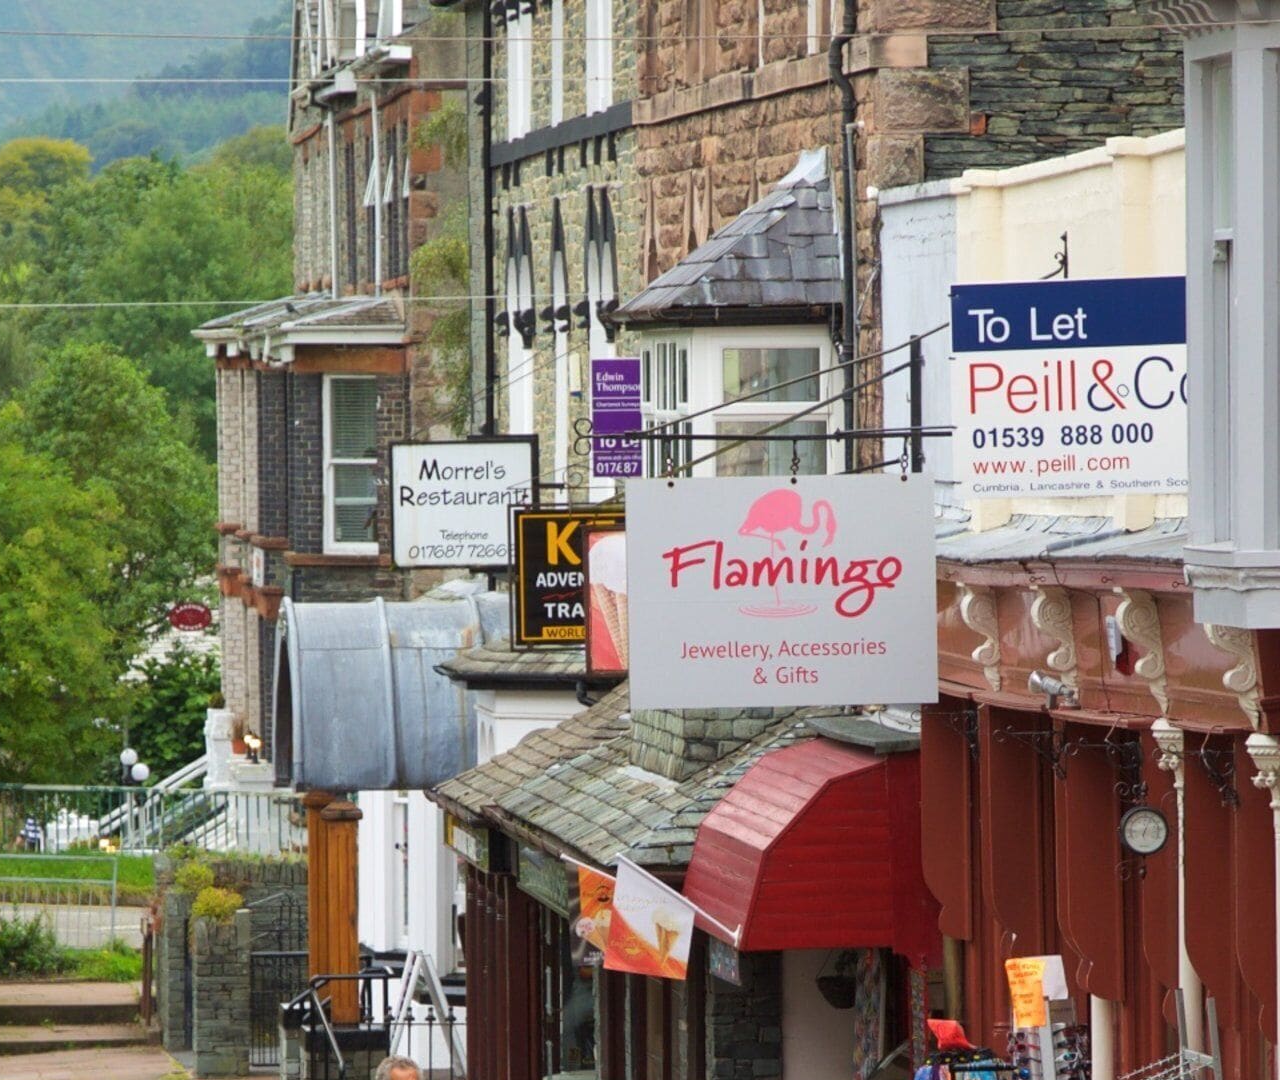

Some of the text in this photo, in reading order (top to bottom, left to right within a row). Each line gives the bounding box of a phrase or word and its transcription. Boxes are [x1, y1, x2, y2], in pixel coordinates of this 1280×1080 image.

[968, 306, 1088, 343] To Let
[596, 372, 624, 381] Edwin
[972, 422, 1154, 449] 01539 888 000
[419, 459, 506, 481] Morrel's
[1030, 480, 1090, 491] Lancashire
[1096, 480, 1104, 489] &
[1110, 478, 1160, 489] Southern
[400, 486, 522, 507] Restaurant
[440, 529, 488, 542] Telephone
[409, 544, 464, 559] 017687
[662, 539, 903, 618] Flamingo
[680, 638, 886, 660] Jewellery, Accessories
[753, 666, 818, 684] & Gifts
